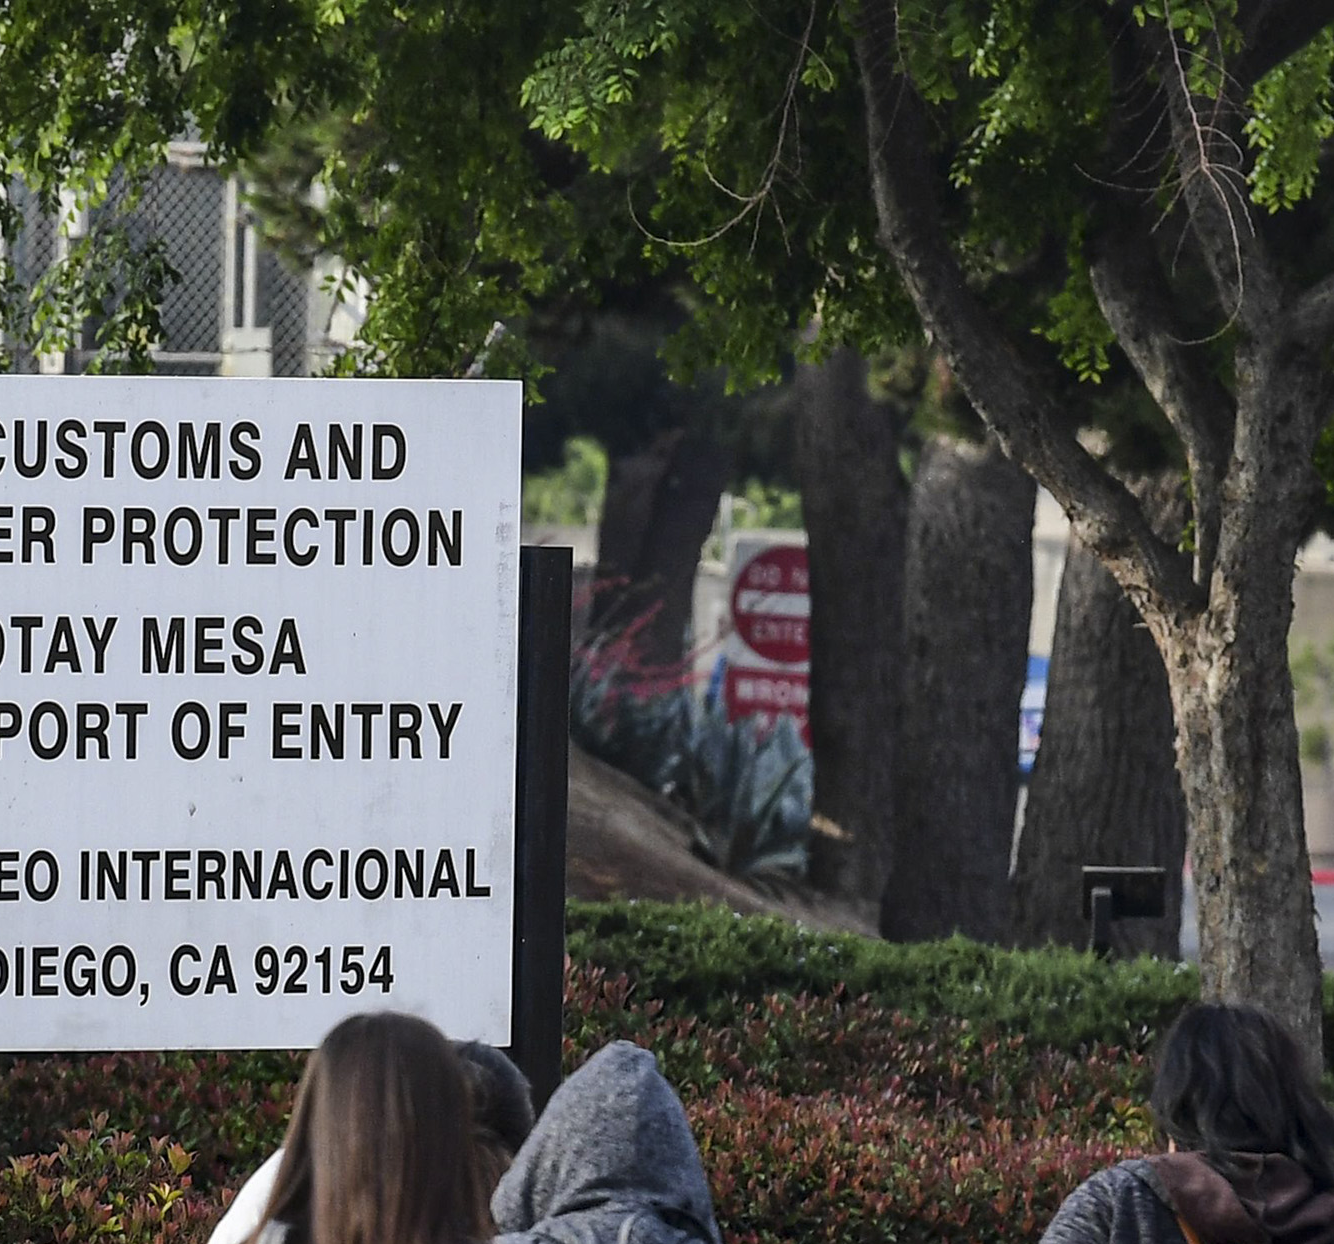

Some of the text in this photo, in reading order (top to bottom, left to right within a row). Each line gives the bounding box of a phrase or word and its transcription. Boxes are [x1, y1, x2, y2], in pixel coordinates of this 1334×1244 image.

[283, 423, 407, 481] AND
[82, 506, 463, 567] PROTECTION
[141, 615, 307, 675] MESA
[171, 701, 248, 761] OF
[272, 702, 463, 760] ENTRY
[80, 848, 491, 901] INTERNACIONAL
[169, 944, 238, 996] CA
[254, 945, 394, 996] 92154
